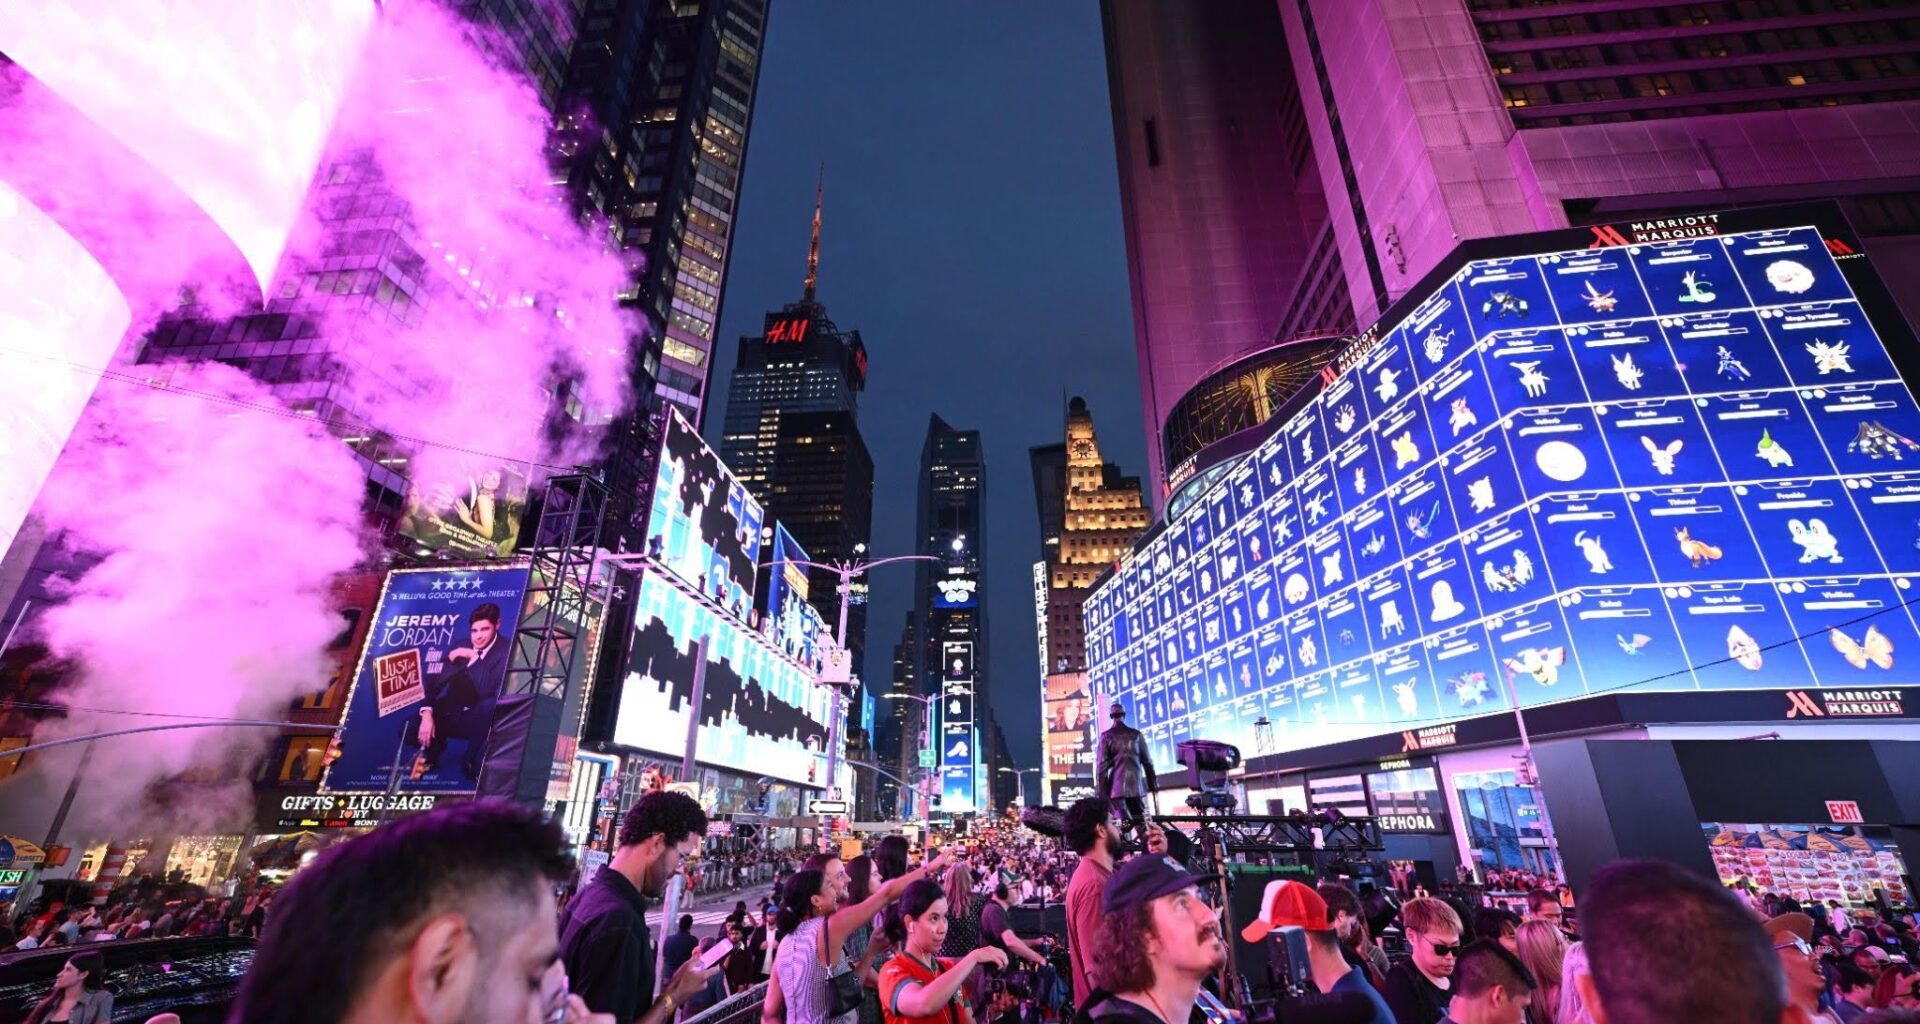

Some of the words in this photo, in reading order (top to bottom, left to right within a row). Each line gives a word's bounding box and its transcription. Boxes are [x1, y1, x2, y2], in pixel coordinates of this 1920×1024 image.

[1631, 214, 1719, 231] MARRIOTT
[1636, 226, 1715, 242] MARQUIS
[765, 319, 808, 344] H&M
[1338, 323, 1378, 364] MARRIOTT
[1340, 337, 1376, 373] MARQUIS
[1169, 454, 1198, 482] MARRIOTT
[428, 592, 452, 600] GOOD
[386, 613, 460, 627] JEREMY
[379, 626, 454, 647] JORDAN
[382, 658, 410, 679] JUST
[389, 669, 420, 692] TIME
[1822, 690, 1902, 701] MARRIOTT
[1828, 702, 1899, 714] MARQUIS
[1418, 724, 1457, 738] MARRIOTT
[1052, 753, 1075, 765] THE
[1380, 759, 1411, 770] SEPHORA
[281, 795, 334, 810] GIFTS
[1828, 802, 1859, 821] EXIT
